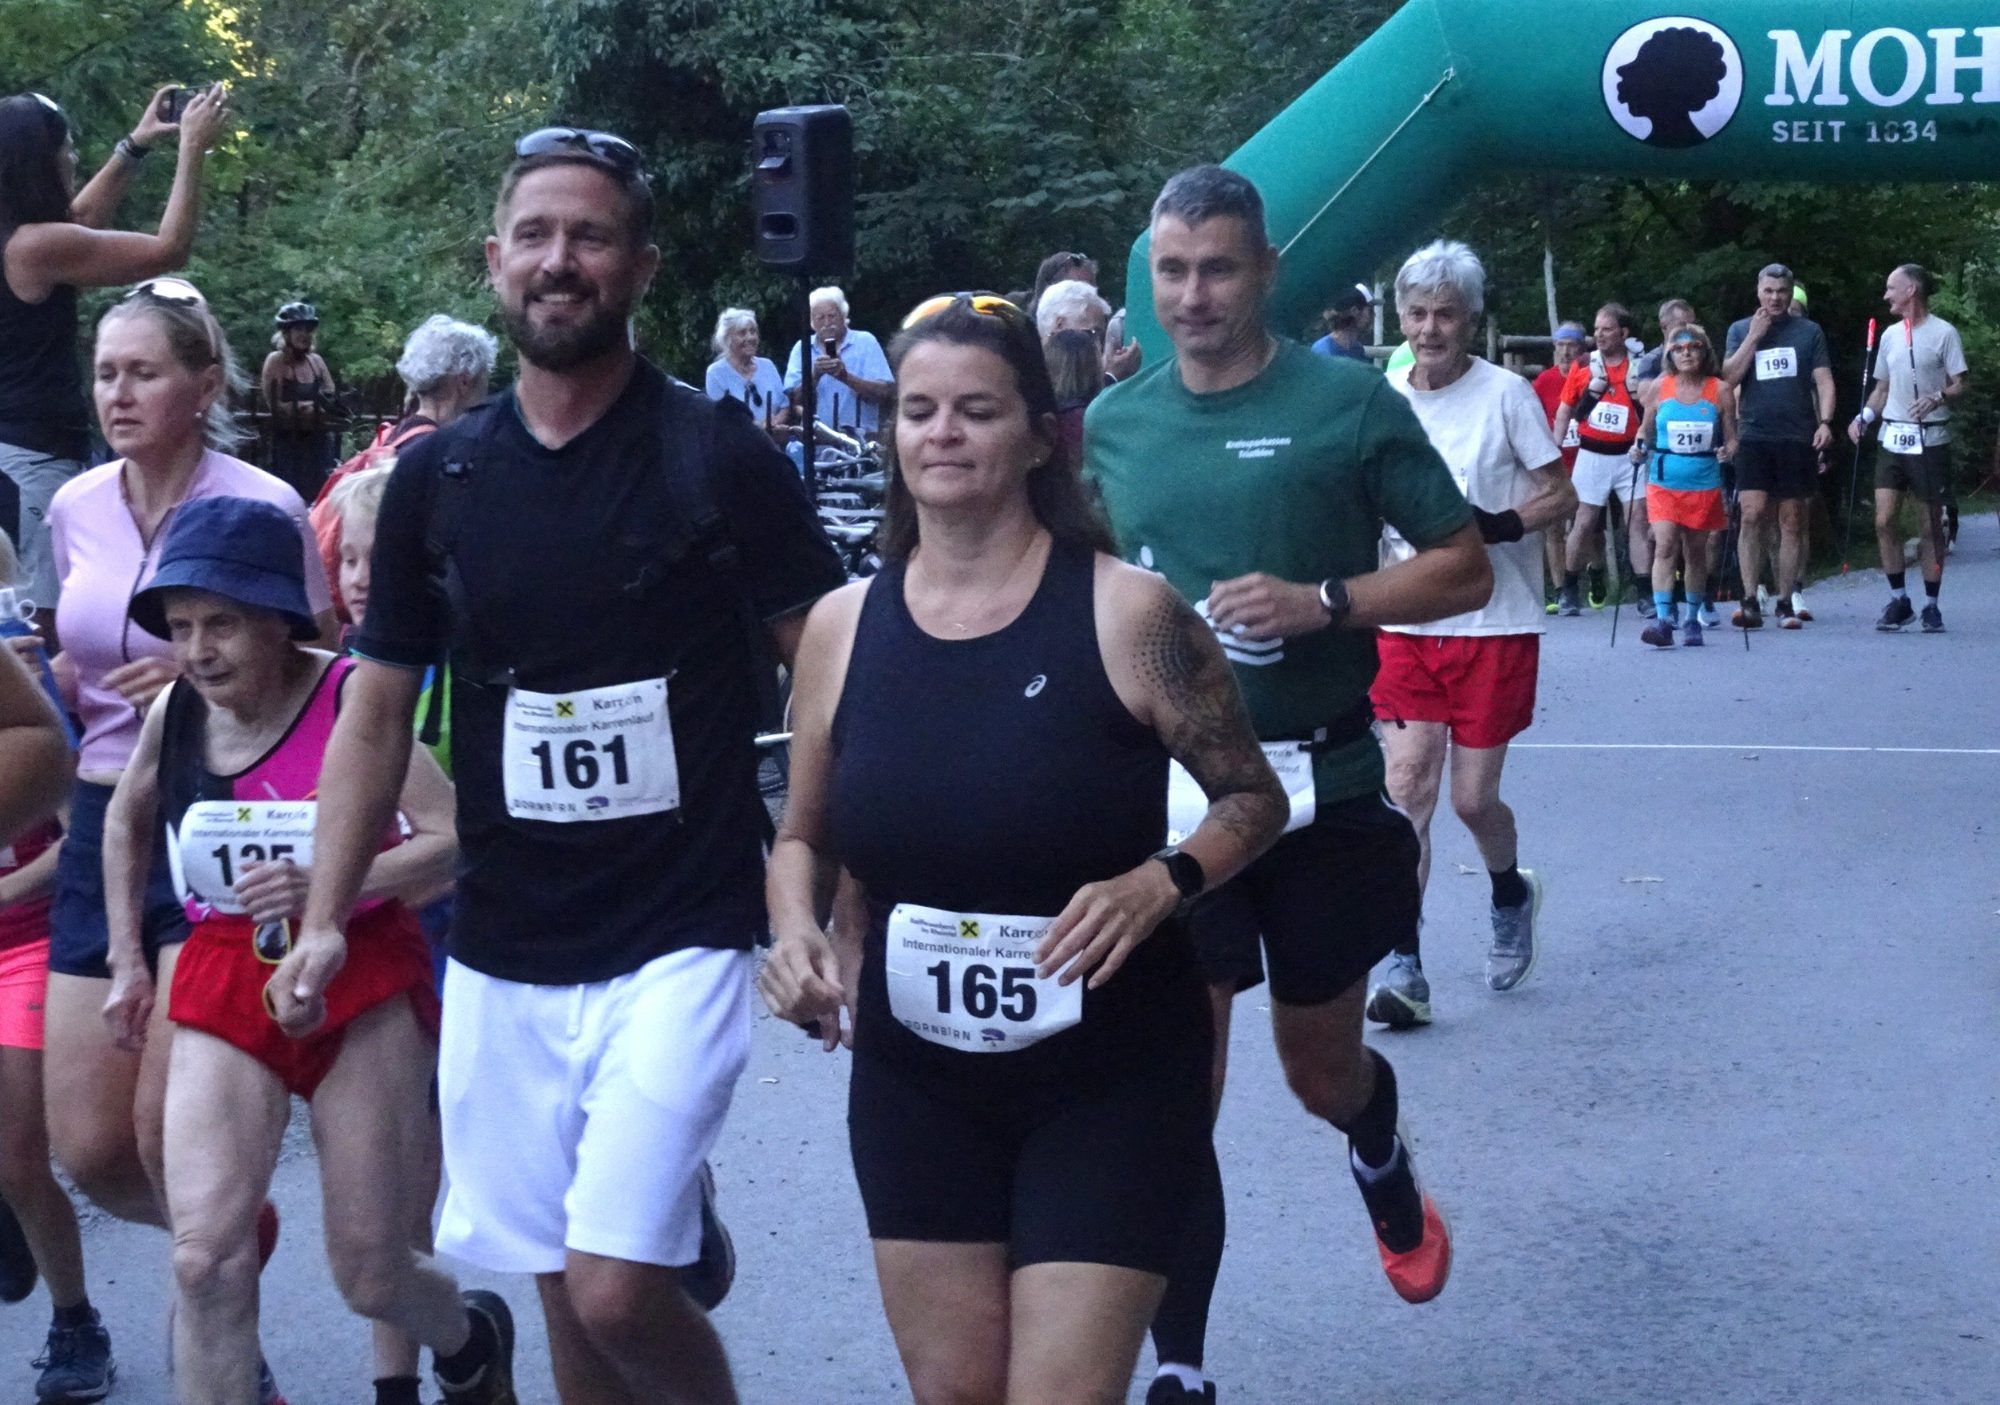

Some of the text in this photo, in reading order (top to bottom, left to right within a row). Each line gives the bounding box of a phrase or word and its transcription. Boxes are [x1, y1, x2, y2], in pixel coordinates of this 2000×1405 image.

[1772, 120, 1846, 143] SEIT
[1765, 357, 1789, 371] 199
[1598, 411, 1619, 425] 193
[1677, 433, 1702, 446] 214
[1893, 433, 1916, 447] 198
[530, 734, 630, 790] 161
[902, 937, 1033, 960] Internationaler Karre
[927, 960, 1037, 1022] 165
